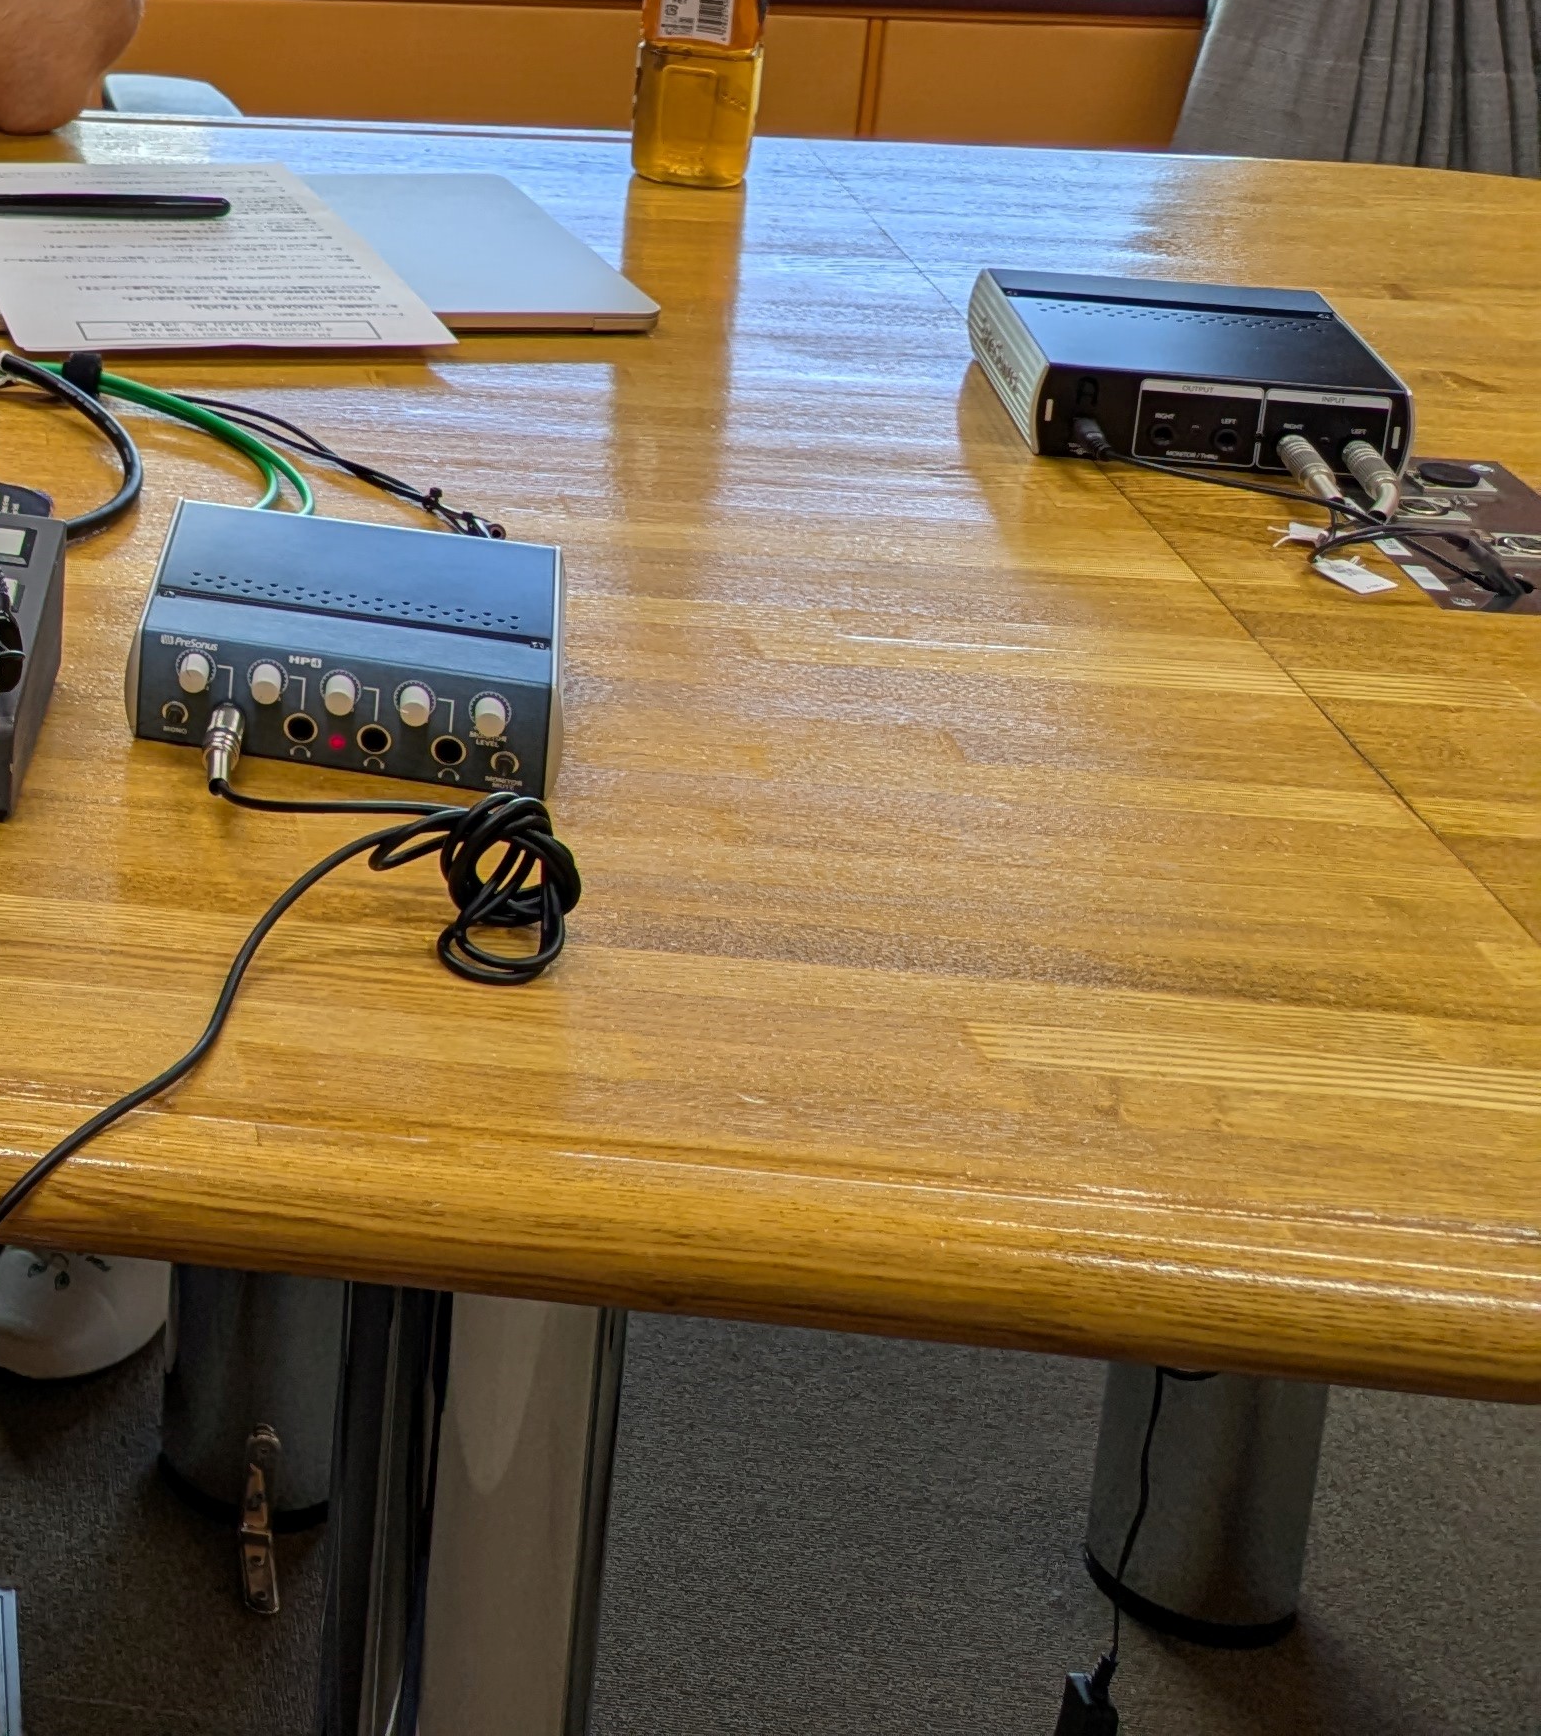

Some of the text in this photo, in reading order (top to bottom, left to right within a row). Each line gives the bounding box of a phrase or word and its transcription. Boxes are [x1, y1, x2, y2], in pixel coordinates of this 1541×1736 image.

[1182, 385, 1214, 394] OUTPUT
[1321, 396, 1346, 404] INPUT
[1283, 423, 1304, 431] RIGHT
[1350, 428, 1367, 436] LEFT
[175, 637, 218, 652] PreSonus
[162, 725, 188, 735] MONO
[484, 775, 523, 787] MONITOR
